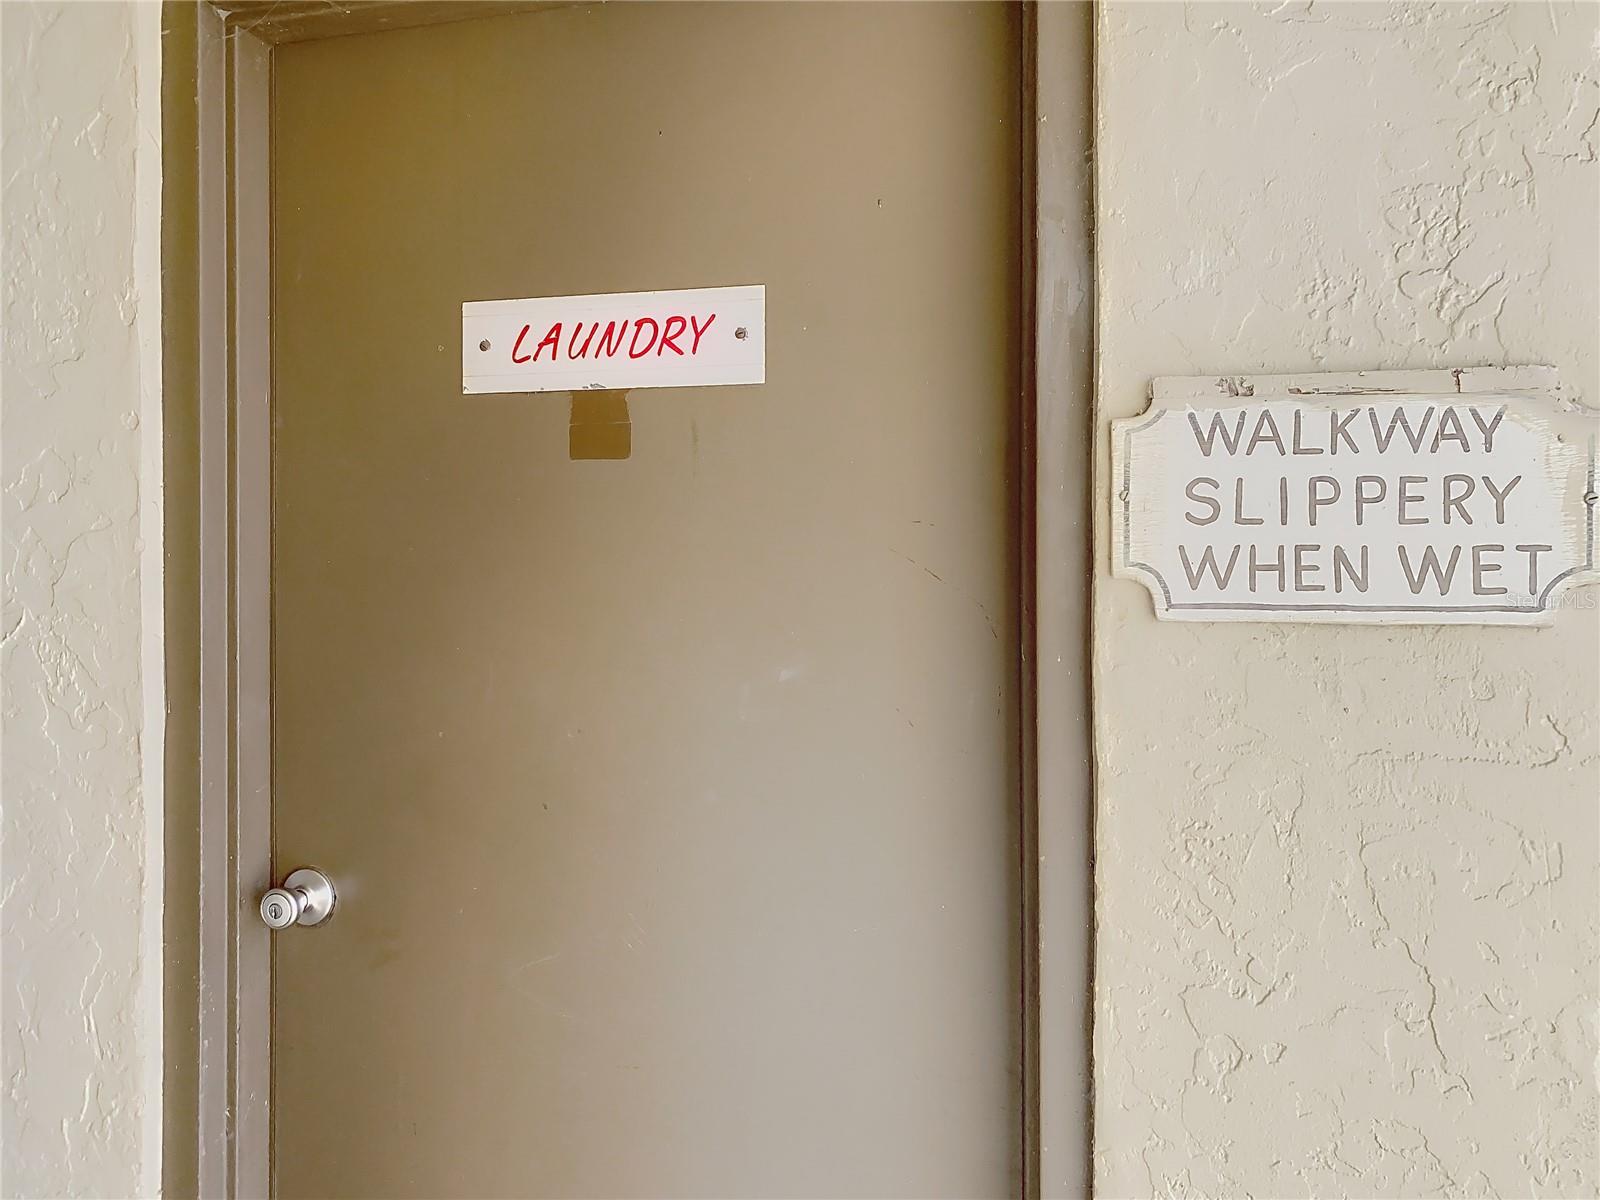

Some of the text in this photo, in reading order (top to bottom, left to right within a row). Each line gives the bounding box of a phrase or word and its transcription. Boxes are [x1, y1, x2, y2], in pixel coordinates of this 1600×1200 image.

[511, 313, 716, 364] LAUNDRY
[1187, 406, 1507, 457] WALKWAY
[1185, 474, 1522, 525] SLIPPERY
[1179, 544, 1553, 596] WHEN WET
